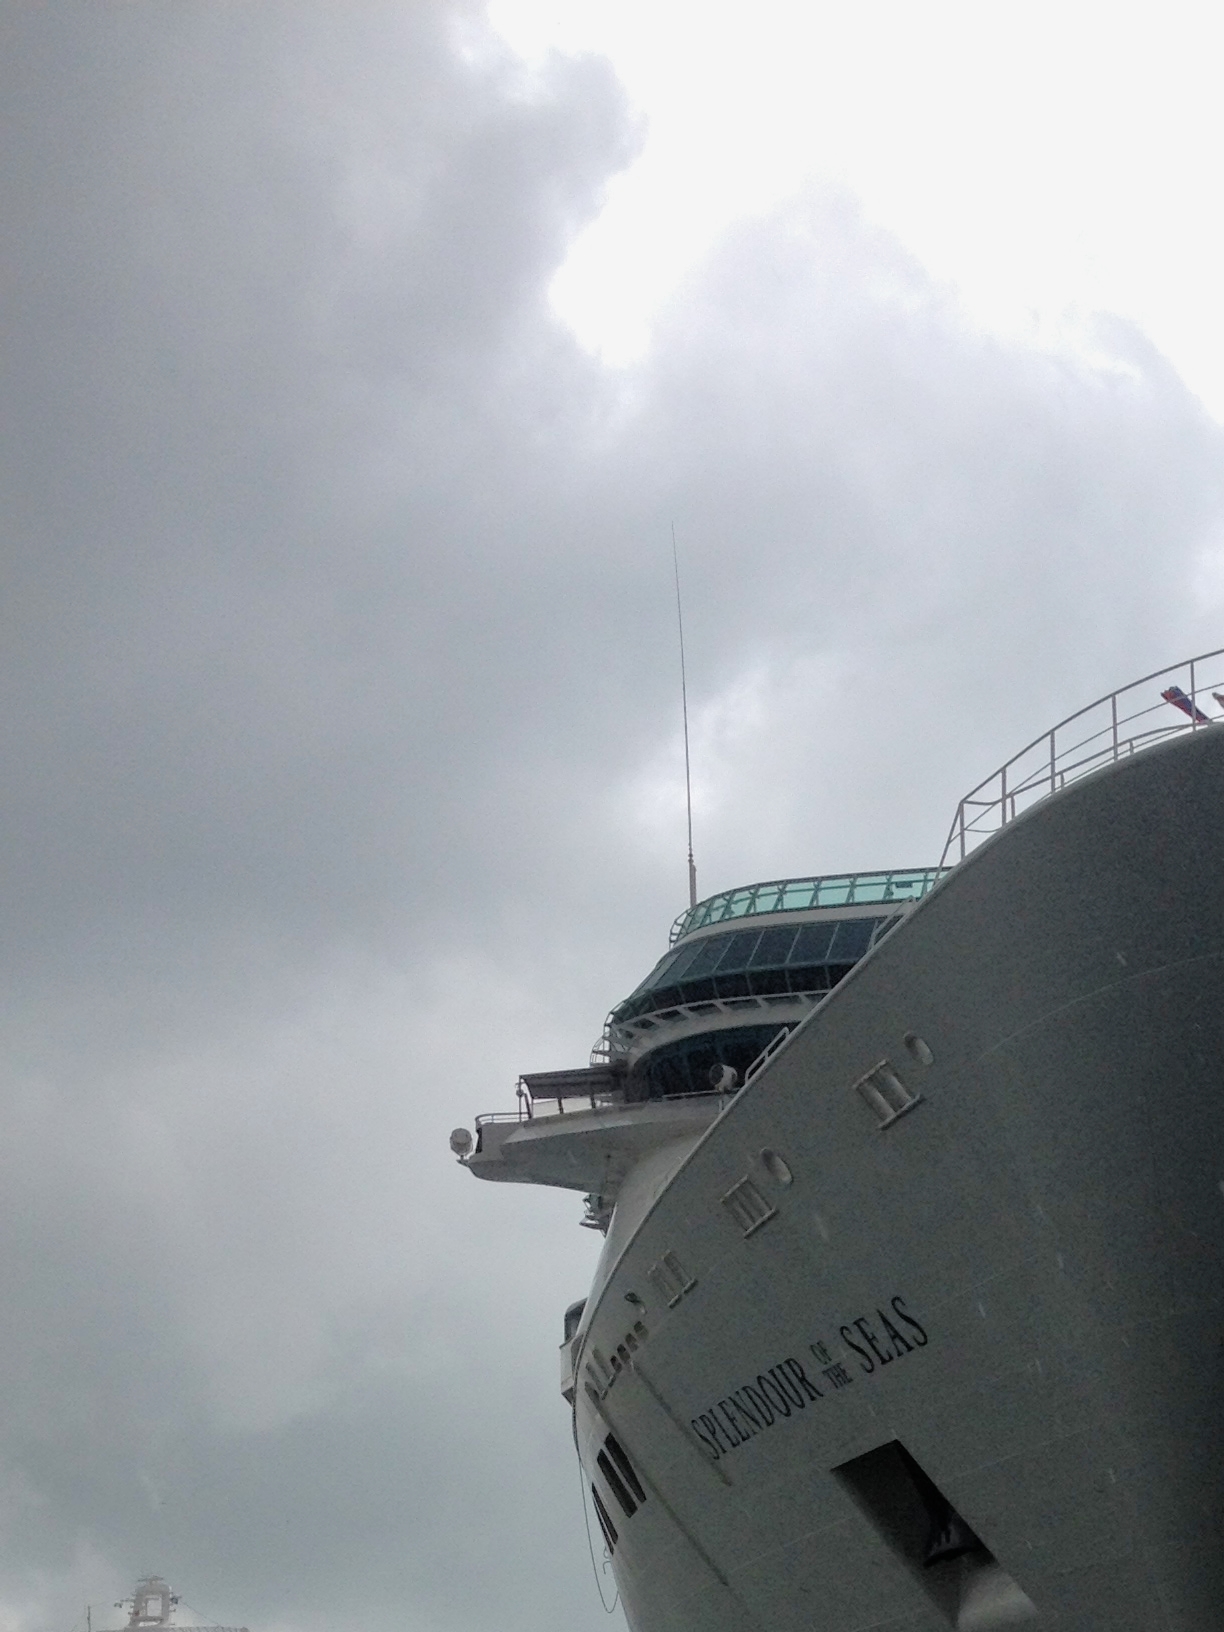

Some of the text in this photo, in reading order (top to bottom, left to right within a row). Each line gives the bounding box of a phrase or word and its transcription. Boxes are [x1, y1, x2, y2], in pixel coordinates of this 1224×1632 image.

[691, 1296, 928, 1460] SPLENDOUR OF THE SEAS
